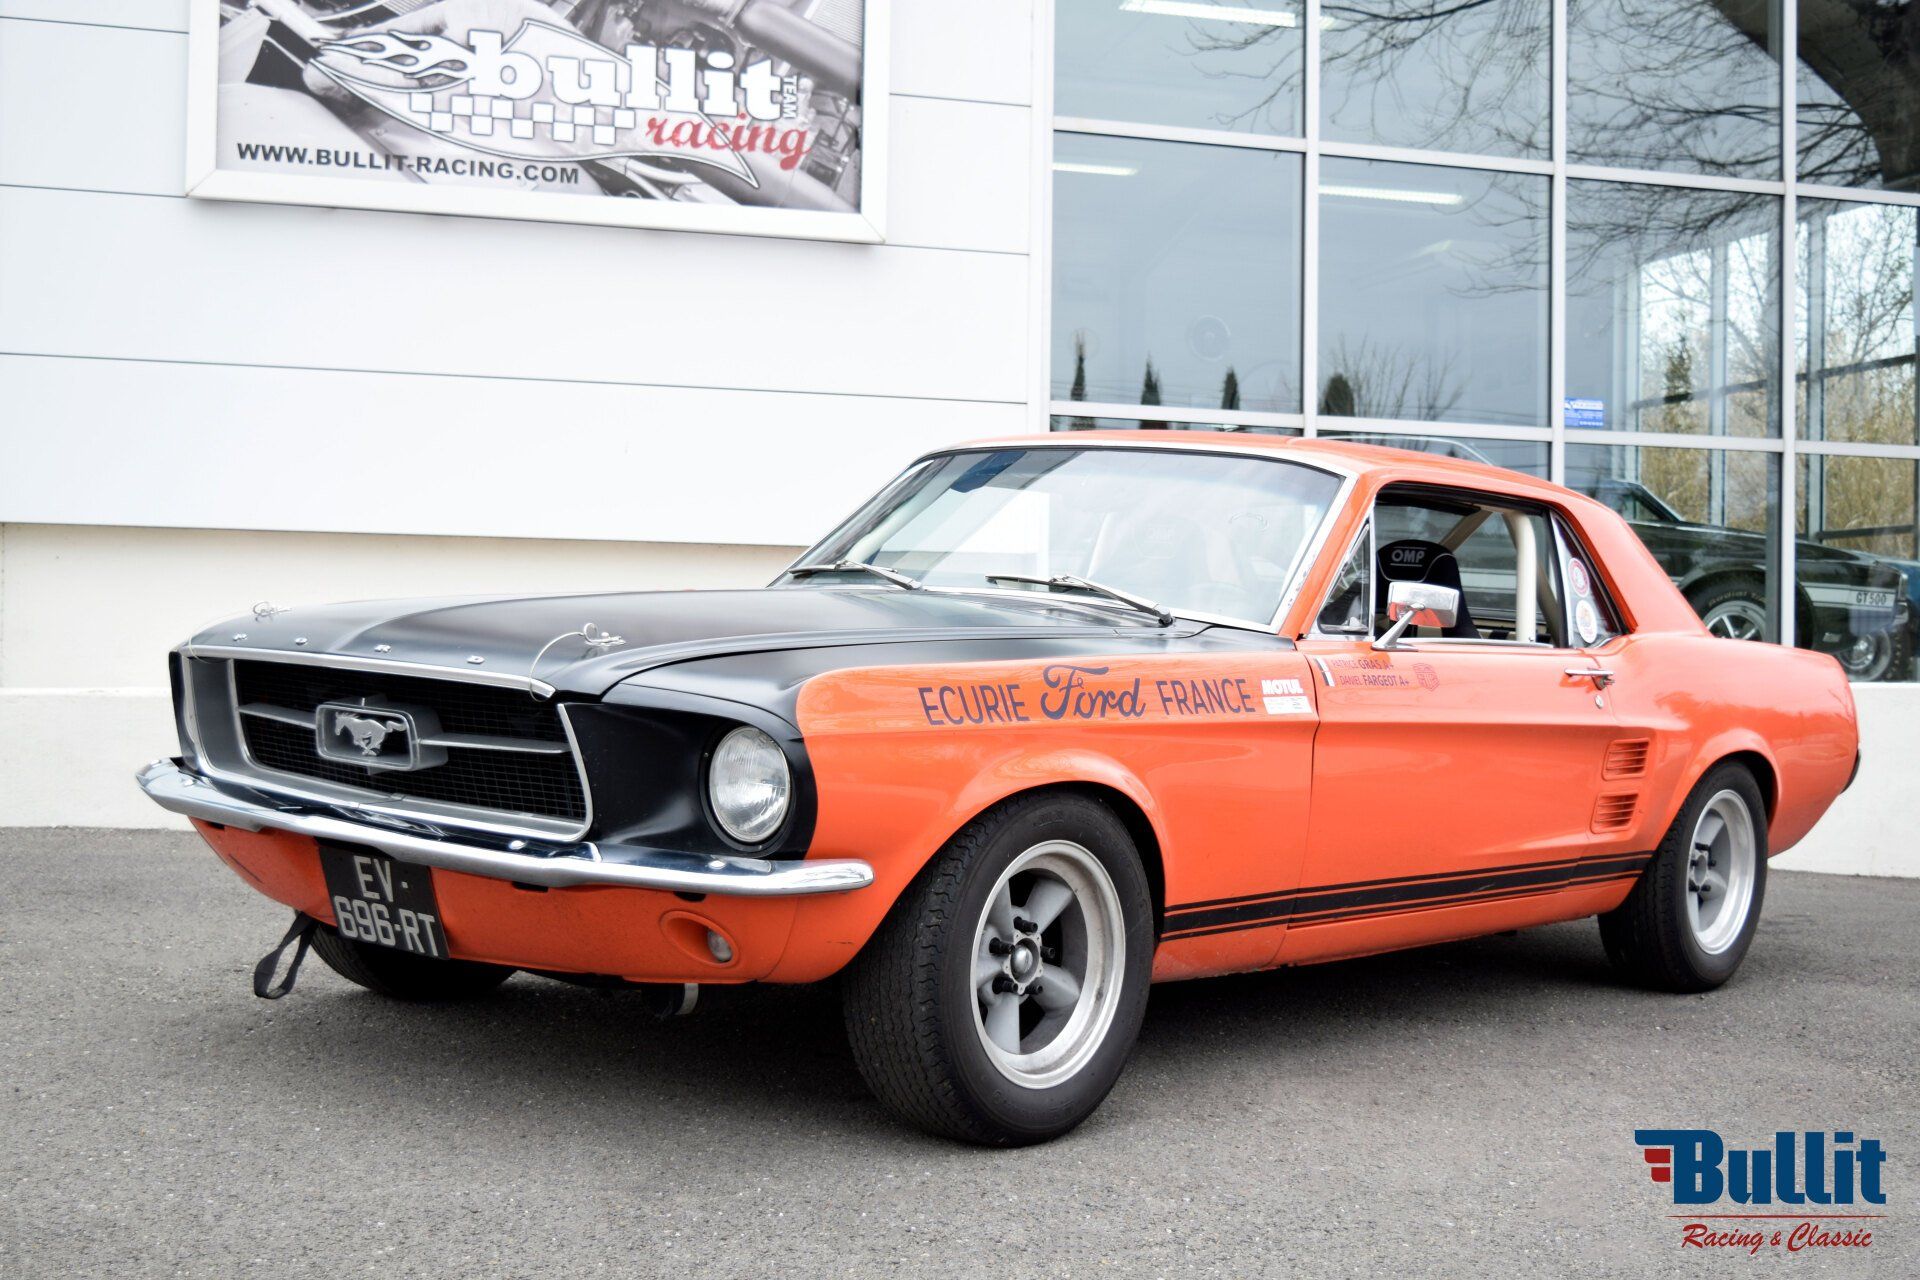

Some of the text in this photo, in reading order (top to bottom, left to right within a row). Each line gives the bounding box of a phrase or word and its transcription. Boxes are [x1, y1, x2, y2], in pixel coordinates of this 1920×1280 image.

[467, 29, 782, 121] bullit
[783, 74, 798, 119] TEAM
[237, 142, 580, 185] WWW.BULLIT-RACING.COM
[645, 112, 812, 171] racing
[1391, 549, 1425, 563] OMP
[1261, 678, 1305, 695] MOTUL
[1339, 675, 1363, 686] DANIEL
[1362, 674, 1397, 686] FARGEOT
[1358, 659, 1383, 670] GRAS
[918, 684, 1030, 726] ECURIE
[1040, 664, 1147, 721] Ford
[1155, 678, 1256, 716] FRANCE
[333, 895, 438, 957] 696-RT
